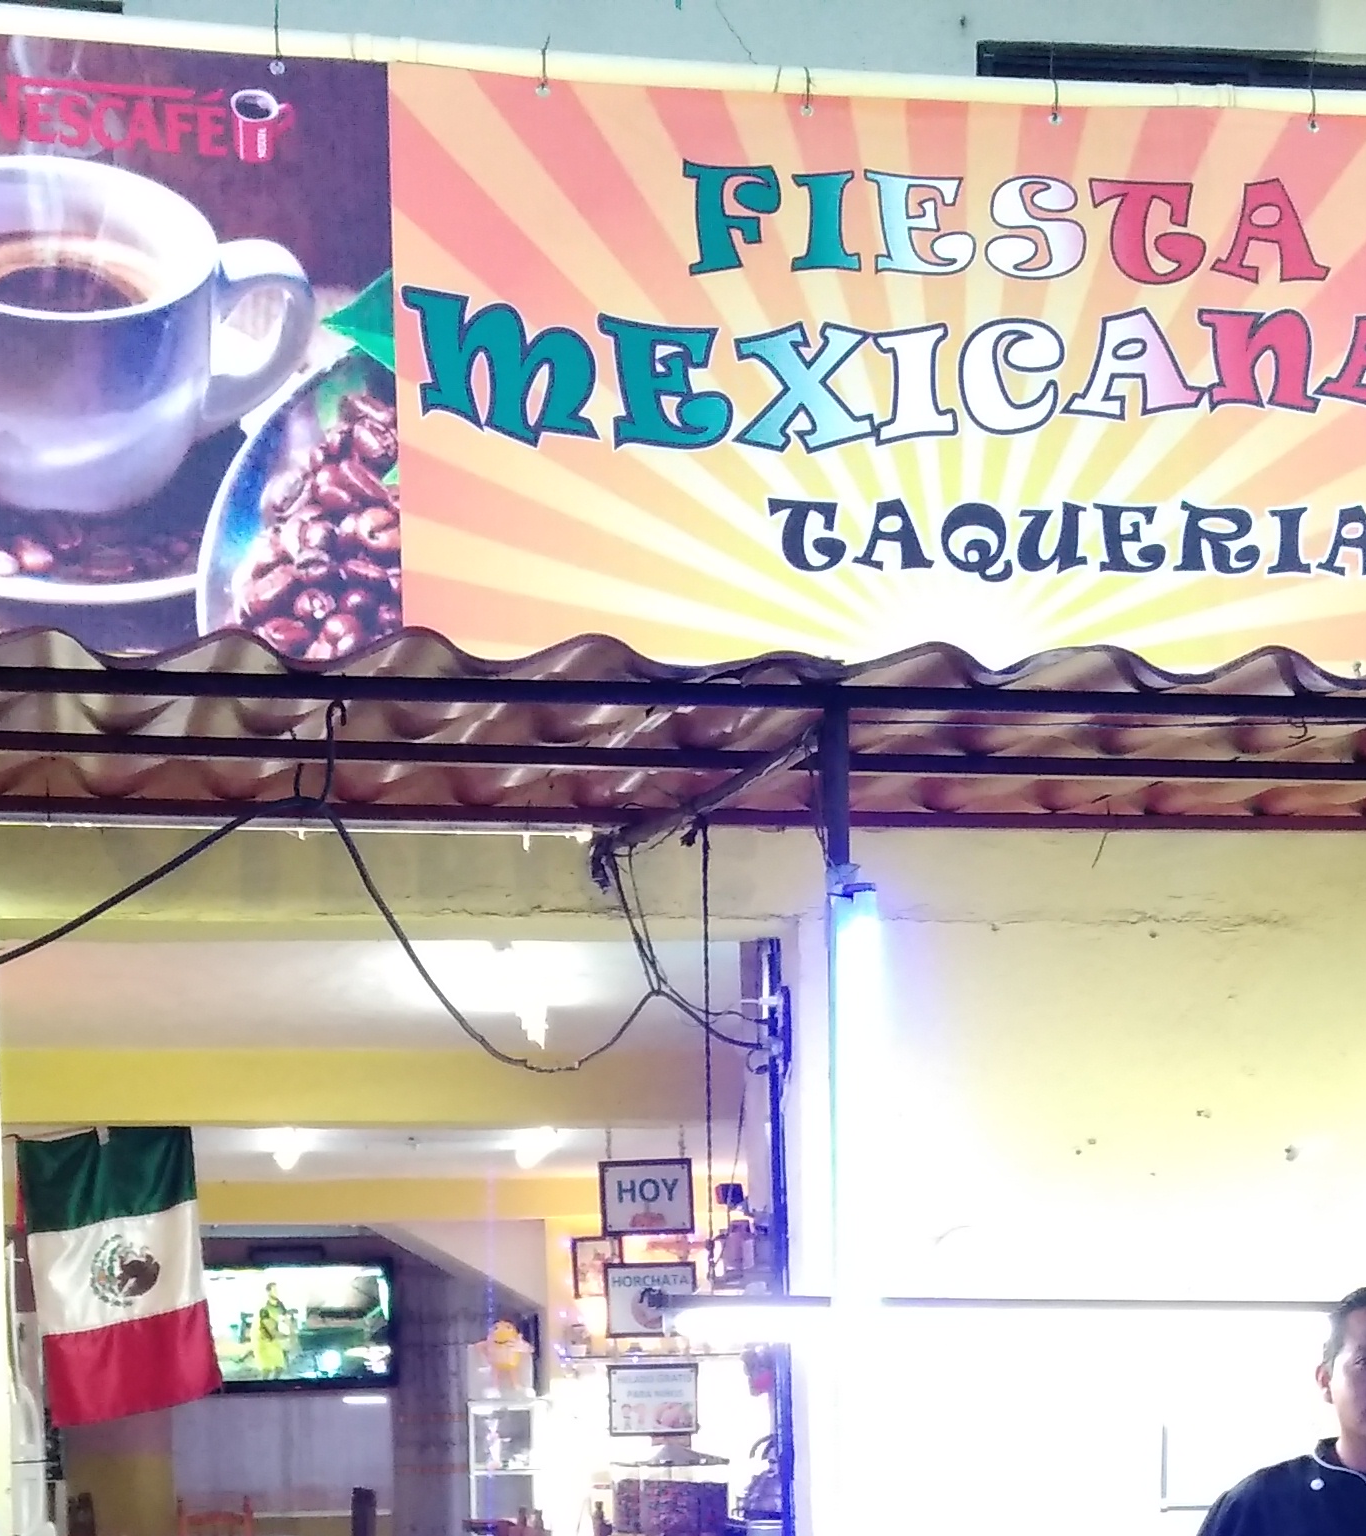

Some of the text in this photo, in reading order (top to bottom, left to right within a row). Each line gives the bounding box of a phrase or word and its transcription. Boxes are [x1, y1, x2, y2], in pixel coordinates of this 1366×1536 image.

[681, 158, 1331, 284] FIESTA
[616, 1178, 679, 1203] HOY
[611, 1274, 690, 1288] HORCHATA
